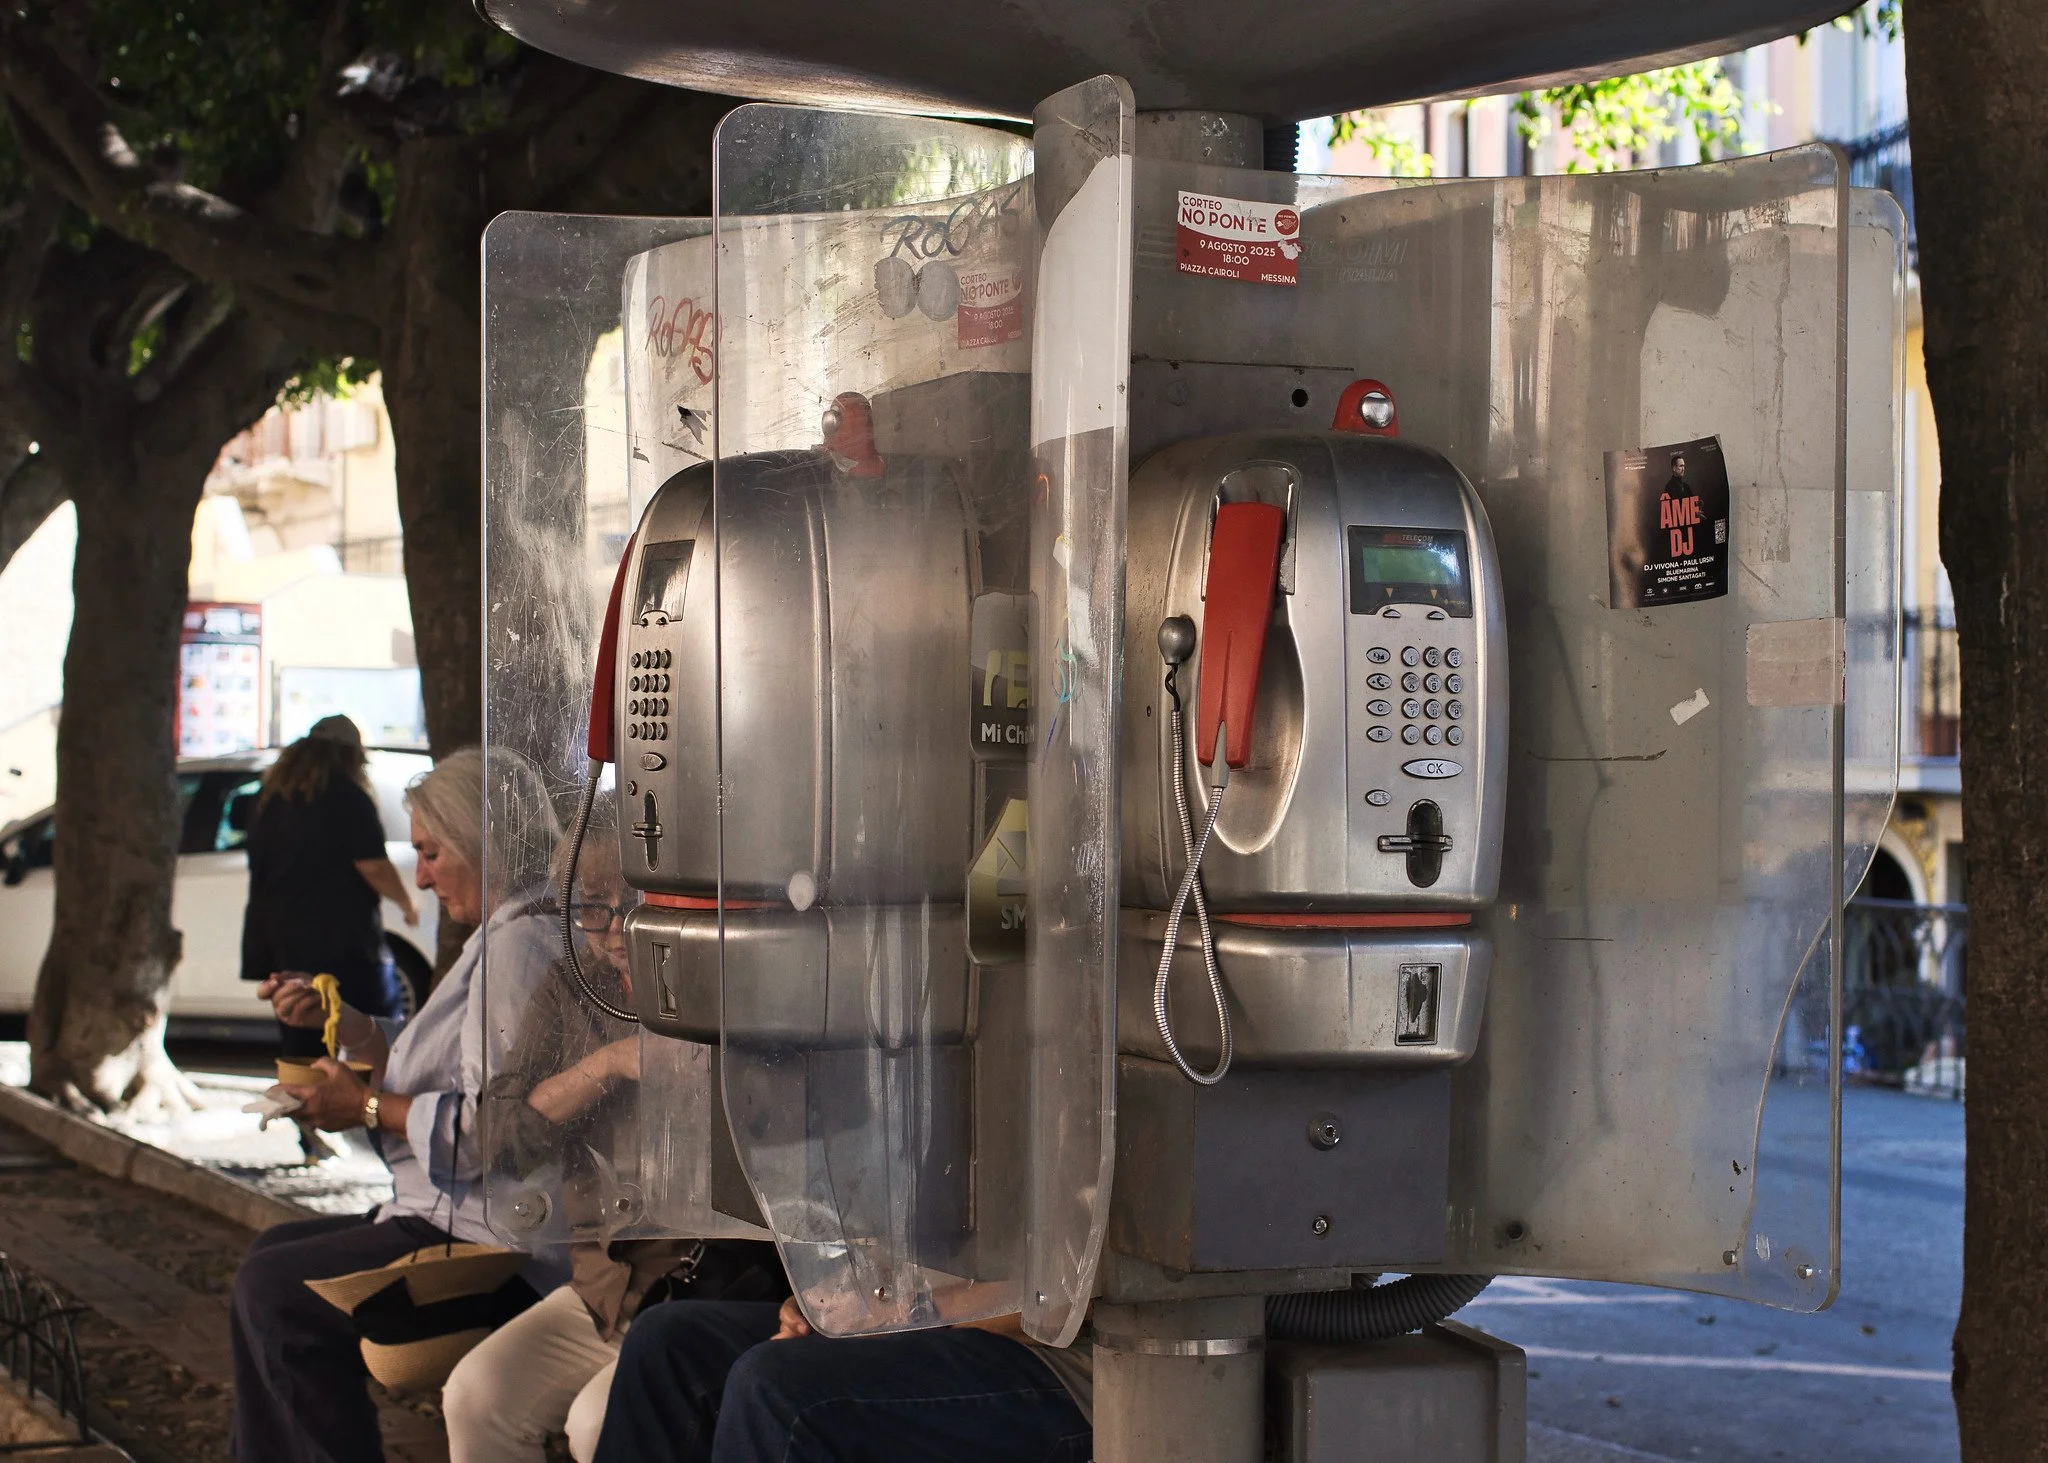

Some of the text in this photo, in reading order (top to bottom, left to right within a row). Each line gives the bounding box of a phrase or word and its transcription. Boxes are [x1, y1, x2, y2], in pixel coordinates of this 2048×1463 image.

[1182, 196, 1222, 211] CORTEO
[1181, 208, 1267, 233] NO PONTE
[1200, 239, 1276, 257] 9 AGOSTO 2025
[1222, 253, 1250, 266] 18:00
[1180, 263, 1240, 279] PIAZZA CAIROLI
[960, 272, 987, 285] CORTEO
[1261, 273, 1297, 284] MESSINA
[960, 279, 1009, 301] NO PONTE
[1660, 492, 1701, 529] ÂME
[1402, 534, 1434, 543] TELECOM
[1670, 527, 1694, 558] DJ
[1643, 563, 1654, 571] DJ
[1654, 560, 1680, 570] VIVONA
[1683, 557, 1699, 567] PAUL
[1666, 566, 1699, 576] BLUEMARINA
[1657, 576, 1678, 584] SIMONE
[1376, 703, 1384, 712] C
[981, 722, 1001, 743] Mi
[1377, 730, 1384, 739] R
[1426, 763, 1444, 774] OK
[1001, 903, 1028, 930] SM
